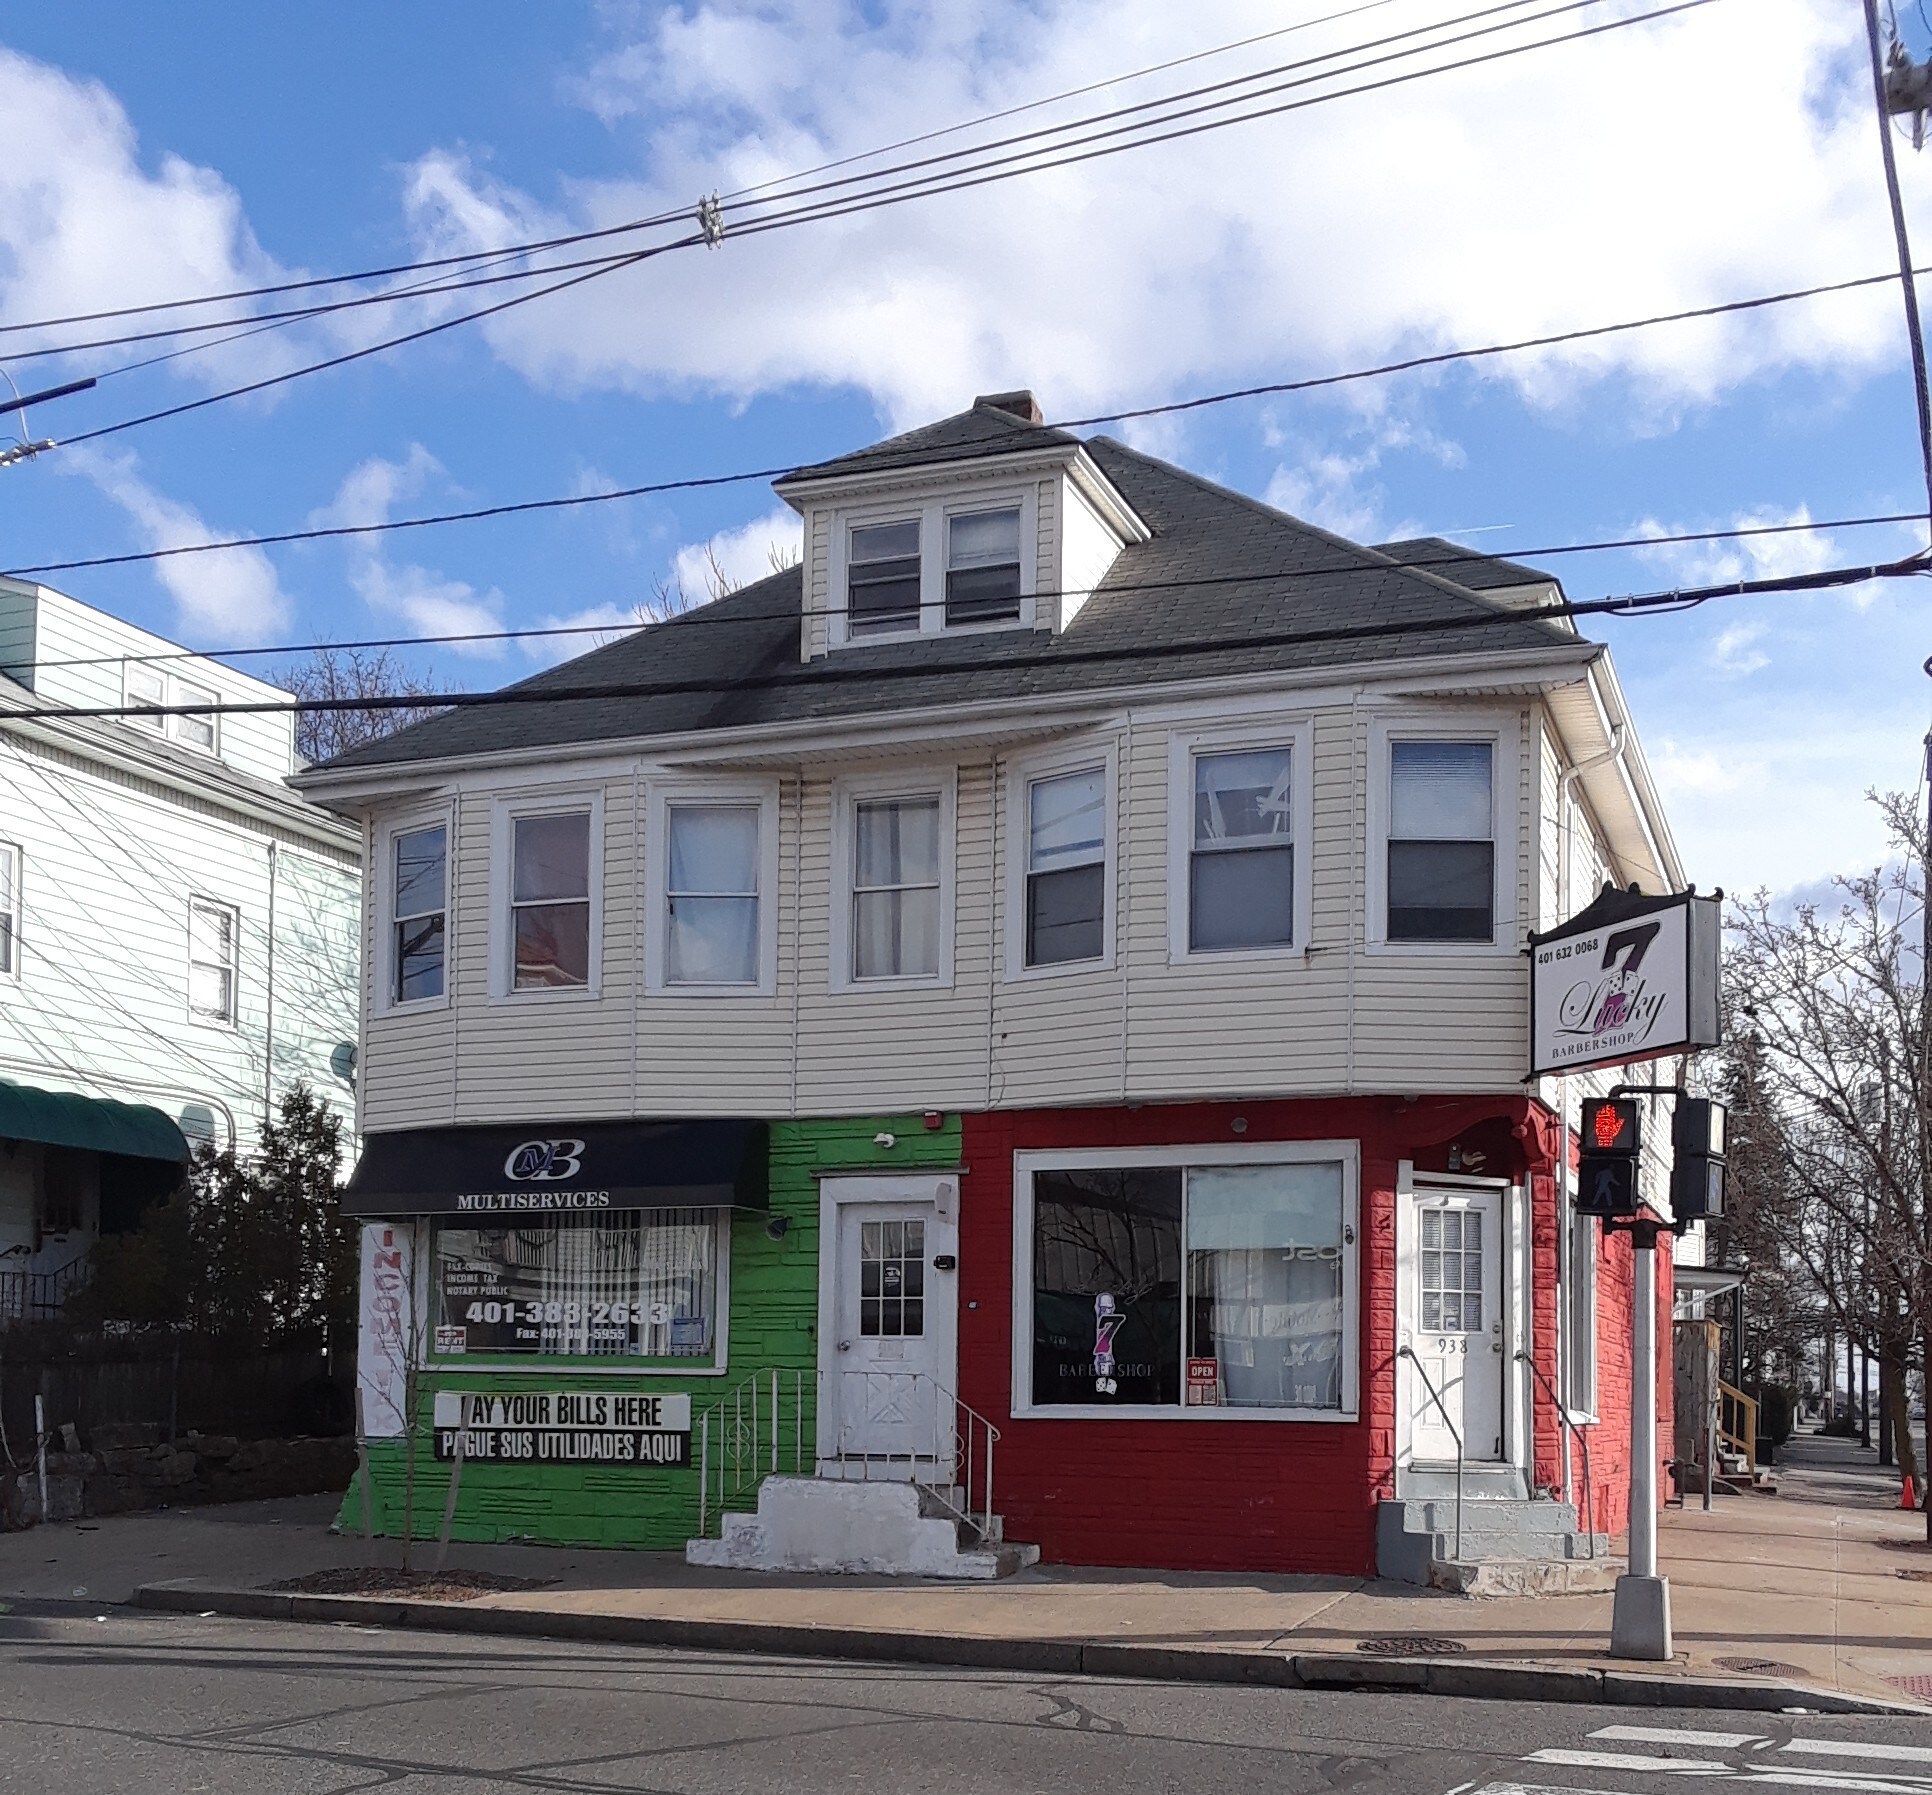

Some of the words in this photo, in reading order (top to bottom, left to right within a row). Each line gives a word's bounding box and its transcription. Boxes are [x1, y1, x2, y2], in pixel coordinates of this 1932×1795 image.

[1538, 951, 1554, 965] 401
[1556, 945, 1572, 960] 632
[1575, 938, 1599, 956] 0068
[1552, 979, 1669, 1046] Lucky
[1551, 1032, 1635, 1059] BARBERSHOP
[456, 1190, 610, 1211] MULTISERVICES
[446, 1273, 479, 1283] INCOME
[483, 1273, 499, 1283] TAX
[446, 1285, 478, 1296] NOTARY
[480, 1286, 509, 1296] PUBLIC
[465, 1301, 669, 1325] 401-383-2633
[516, 1327, 540, 1339] Fax:
[540, 1328, 626, 1341] 401-38-5955
[1093, 1313, 1127, 1355] 7
[1438, 1338, 1468, 1354] 938
[1059, 1362, 1155, 1377] BARBSHOP
[1191, 1365, 1215, 1377] OPEN
[501, 1395, 551, 1425] YOUR
[556, 1395, 607, 1426] BILLS
[613, 1396, 662, 1427] HERE
[500, 1431, 534, 1459] SUS
[537, 1432, 635, 1460] UTILIDADES
[638, 1434, 682, 1464] AQUI
